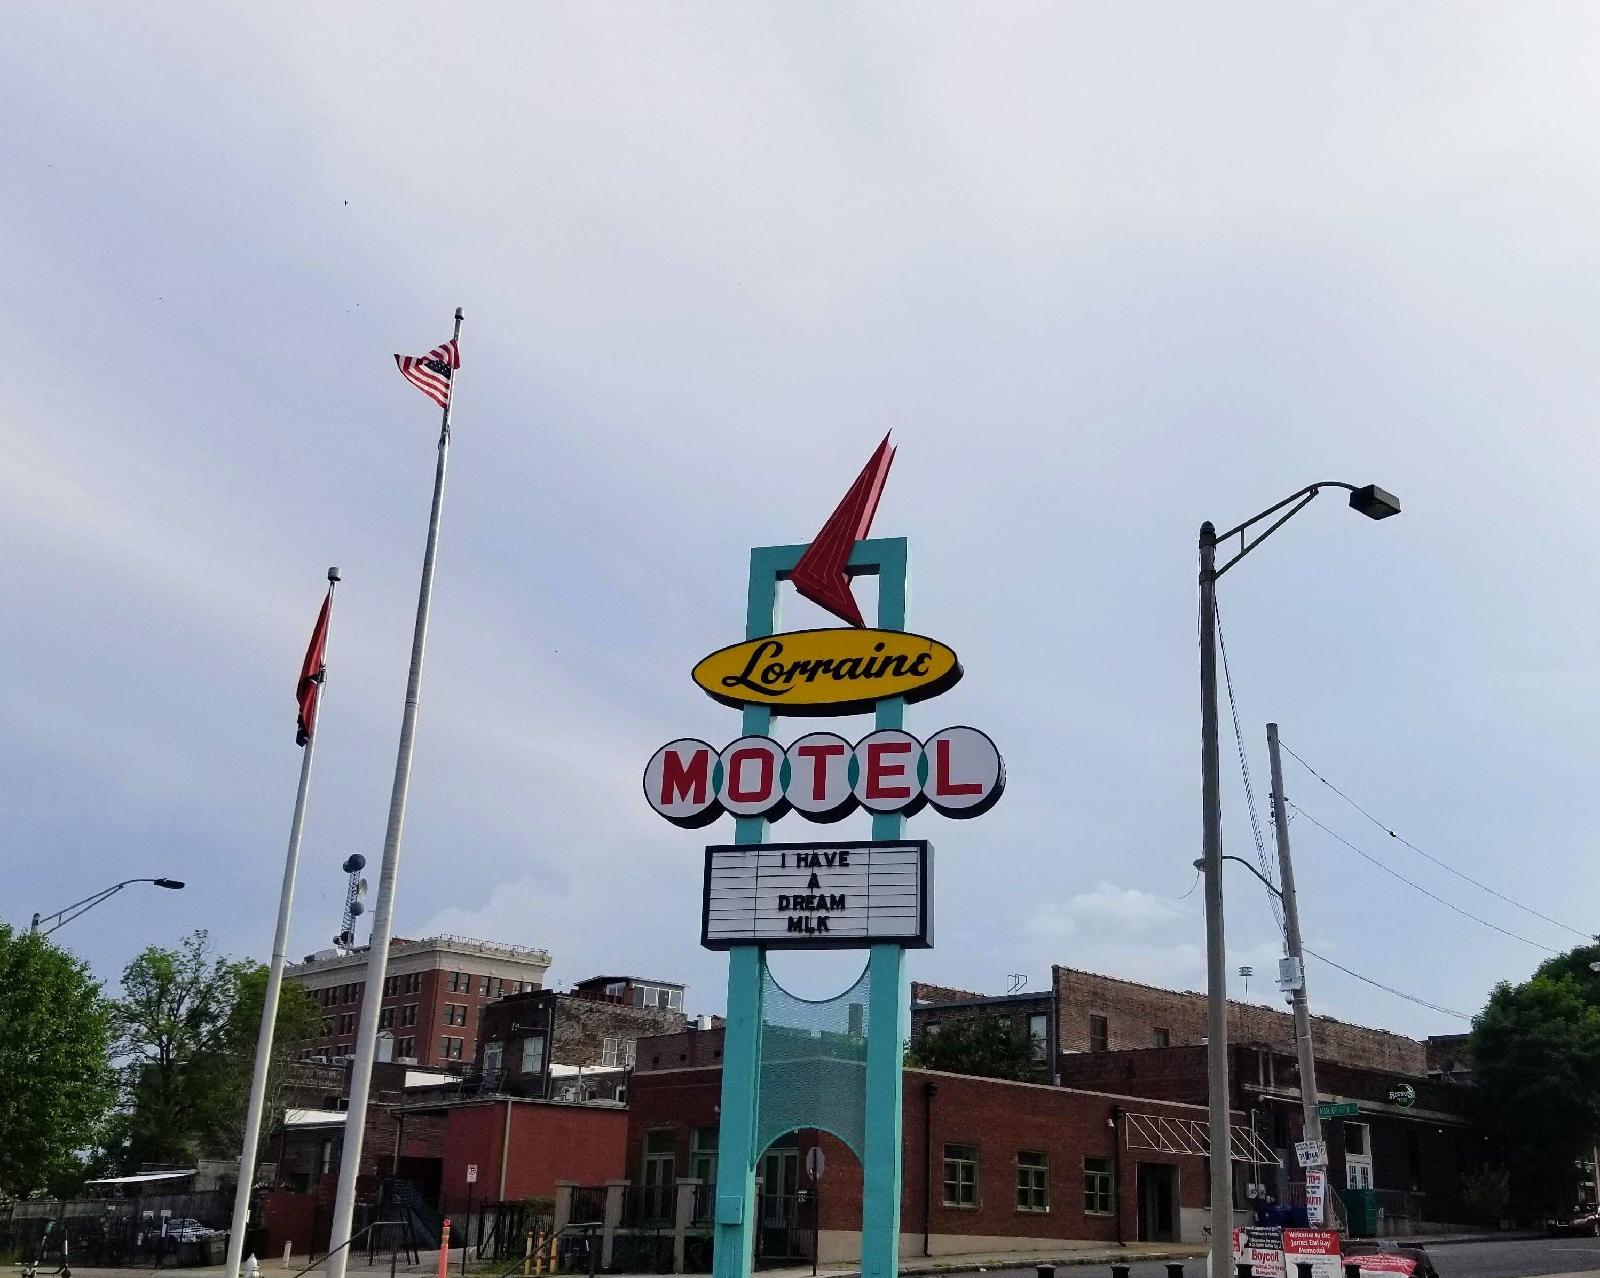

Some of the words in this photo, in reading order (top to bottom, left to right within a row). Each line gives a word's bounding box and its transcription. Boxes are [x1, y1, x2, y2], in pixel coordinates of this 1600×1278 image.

[722, 641, 932, 696] Lorraine
[660, 739, 983, 805] MOTEL
[781, 852, 786, 868] I
[796, 851, 850, 868] HAVE
[807, 873, 820, 889] A
[778, 894, 846, 911] DREAM
[787, 916, 830, 934] MLK
[1290, 1239, 1308, 1247] James
[1251, 1250, 1279, 1264] Boycott
